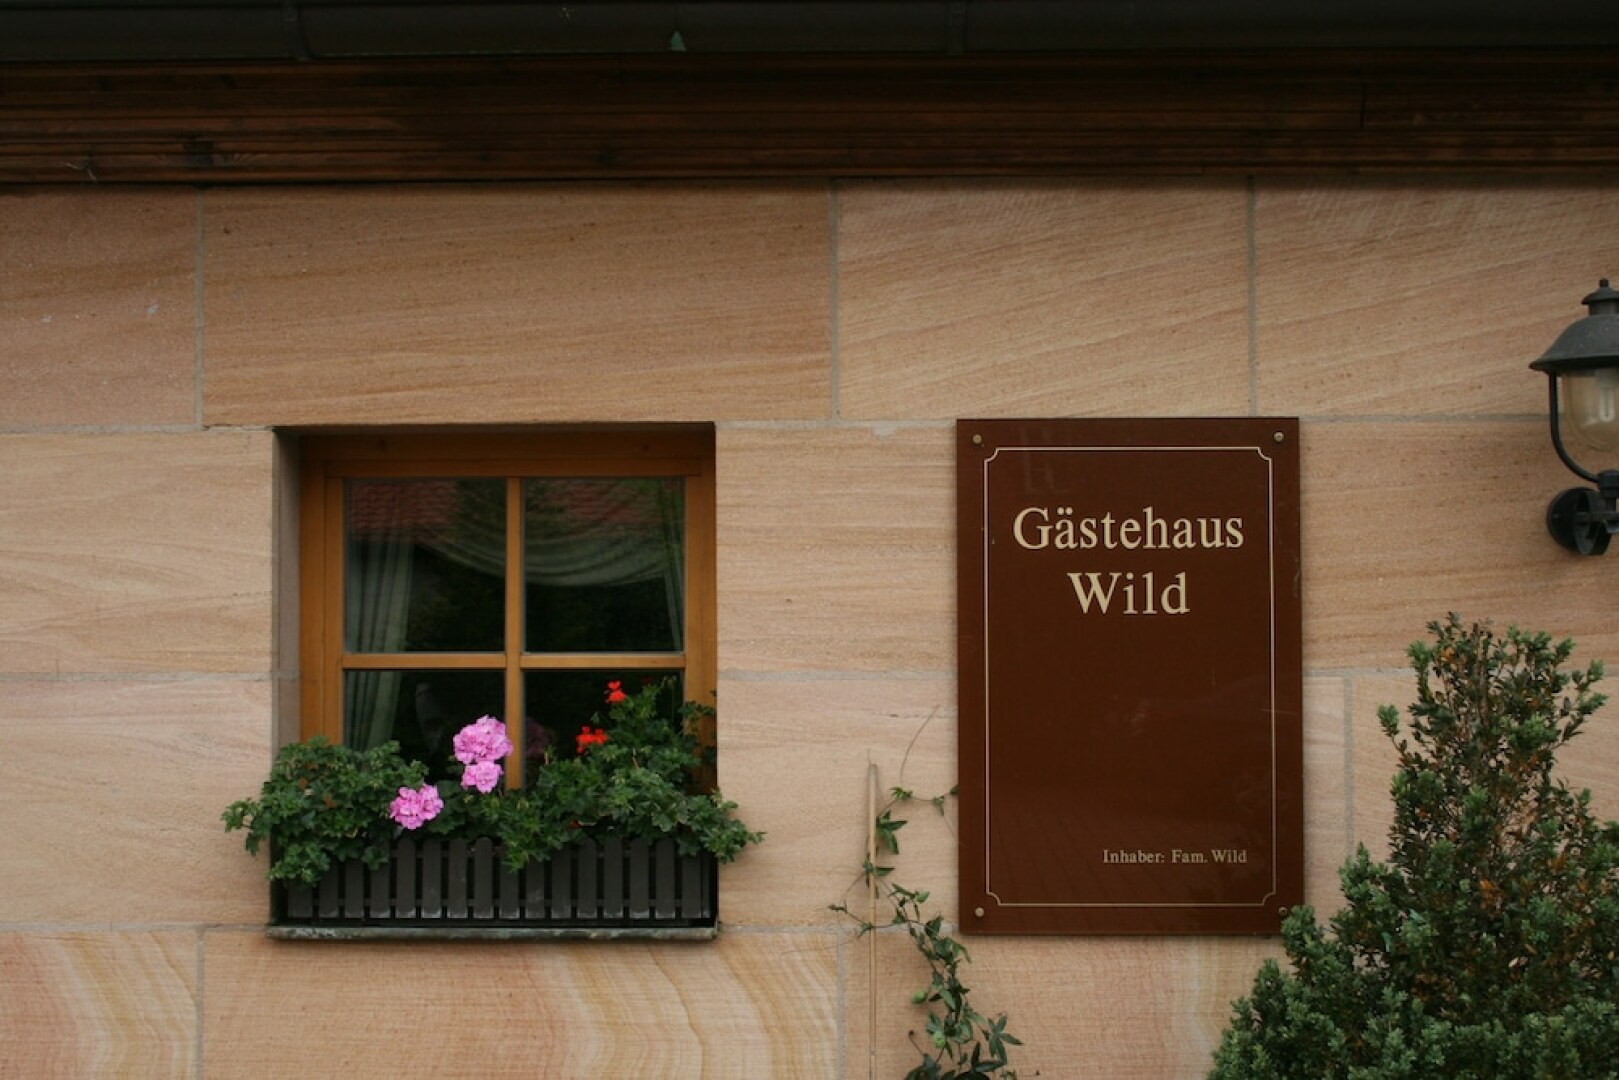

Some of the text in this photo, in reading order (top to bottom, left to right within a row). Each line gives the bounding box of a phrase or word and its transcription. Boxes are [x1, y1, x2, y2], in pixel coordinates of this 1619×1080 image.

[1013, 506, 1244, 550] Gästehaus
[1066, 571, 1191, 614] Wild
[1102, 849, 1248, 864] Inhaber: Fam. Wild
